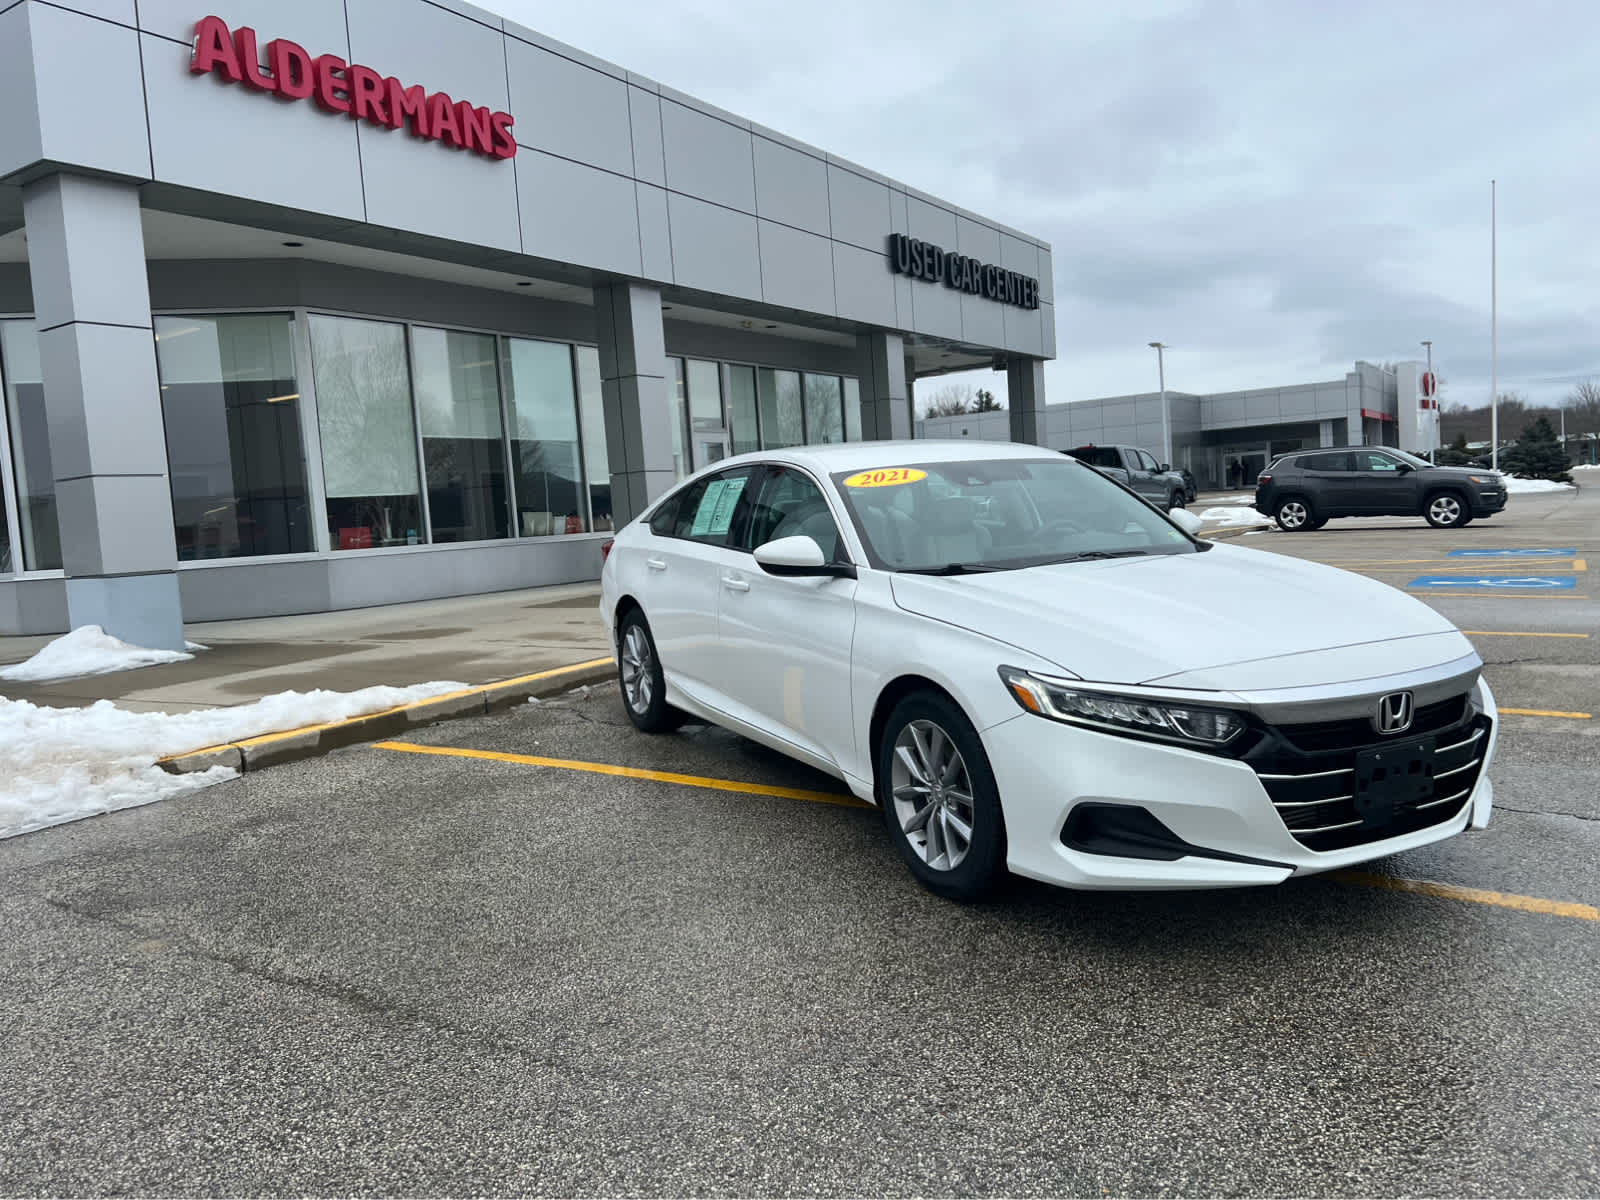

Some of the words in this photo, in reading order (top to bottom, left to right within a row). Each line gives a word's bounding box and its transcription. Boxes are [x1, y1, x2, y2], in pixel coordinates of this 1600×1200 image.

[191, 15, 517, 160] ALDERMANS
[889, 233, 945, 283] USED
[945, 252, 982, 295] CAR
[982, 264, 1040, 310] CENTER
[861, 470, 909, 485] 2021
